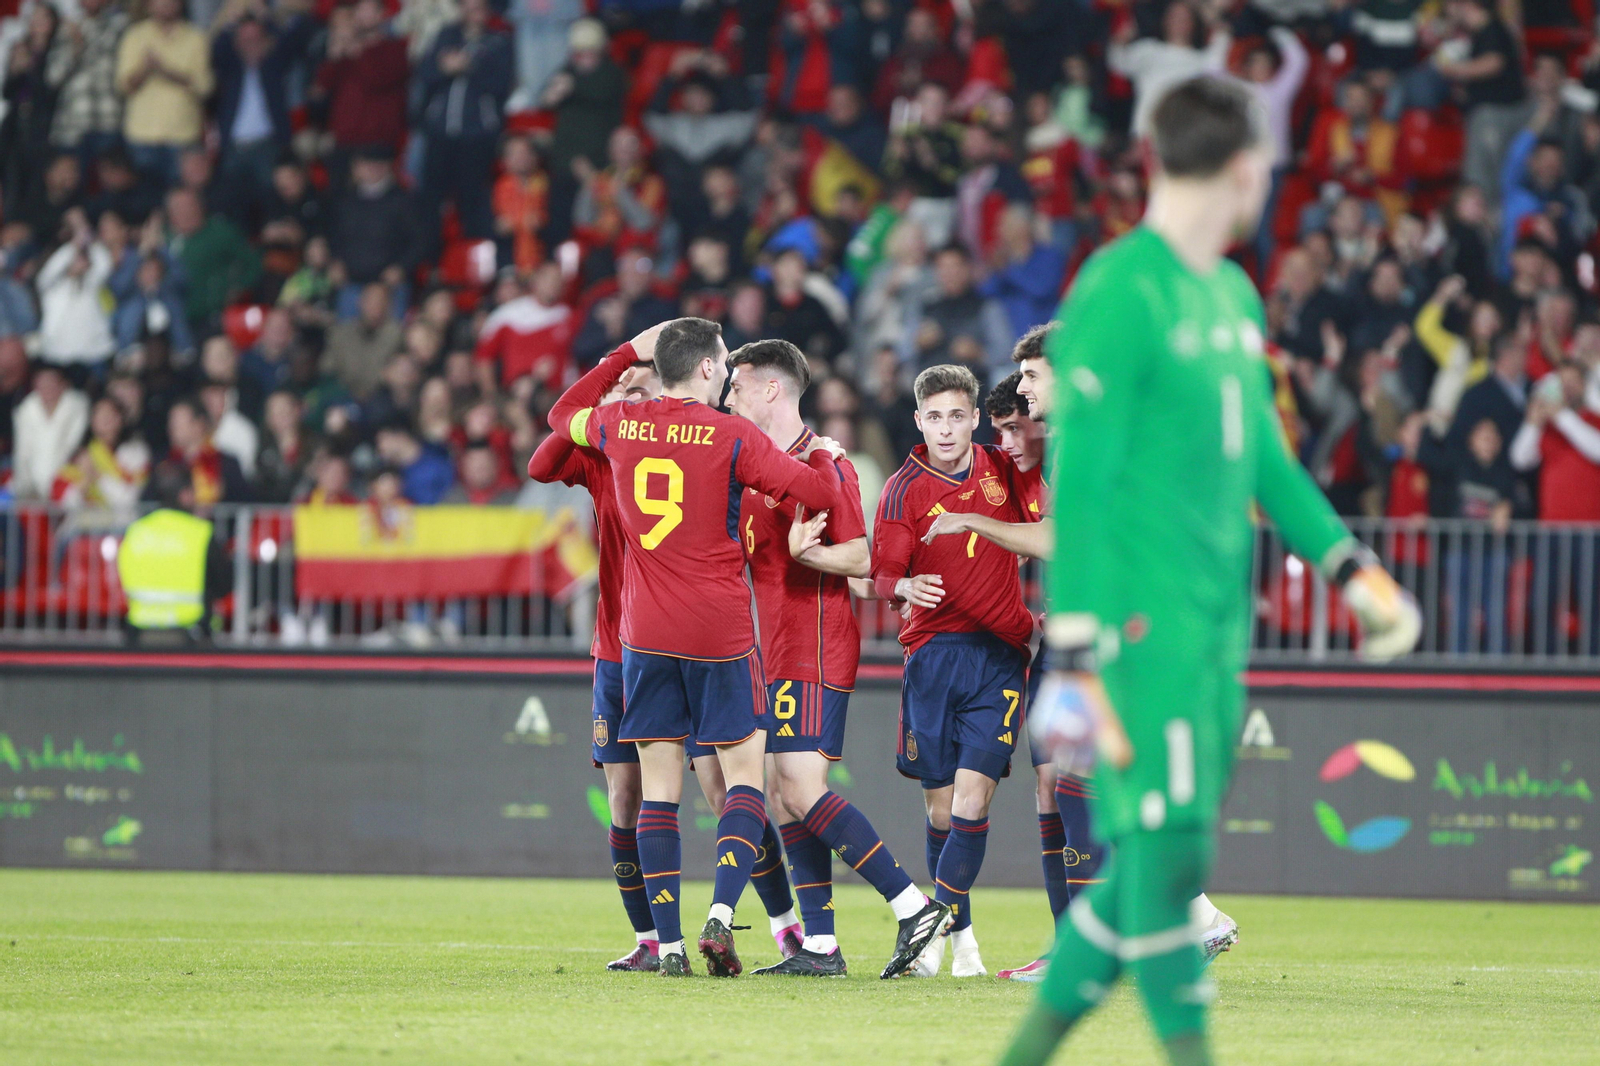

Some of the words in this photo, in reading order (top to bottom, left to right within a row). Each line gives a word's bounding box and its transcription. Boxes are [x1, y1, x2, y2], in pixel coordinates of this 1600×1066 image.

[618, 419, 658, 442] ABEL
[666, 424, 716, 445] RUIZ
[634, 457, 684, 550] 9
[745, 514, 755, 554] 6
[774, 680, 796, 719] 6
[1002, 689, 1020, 727] 7
